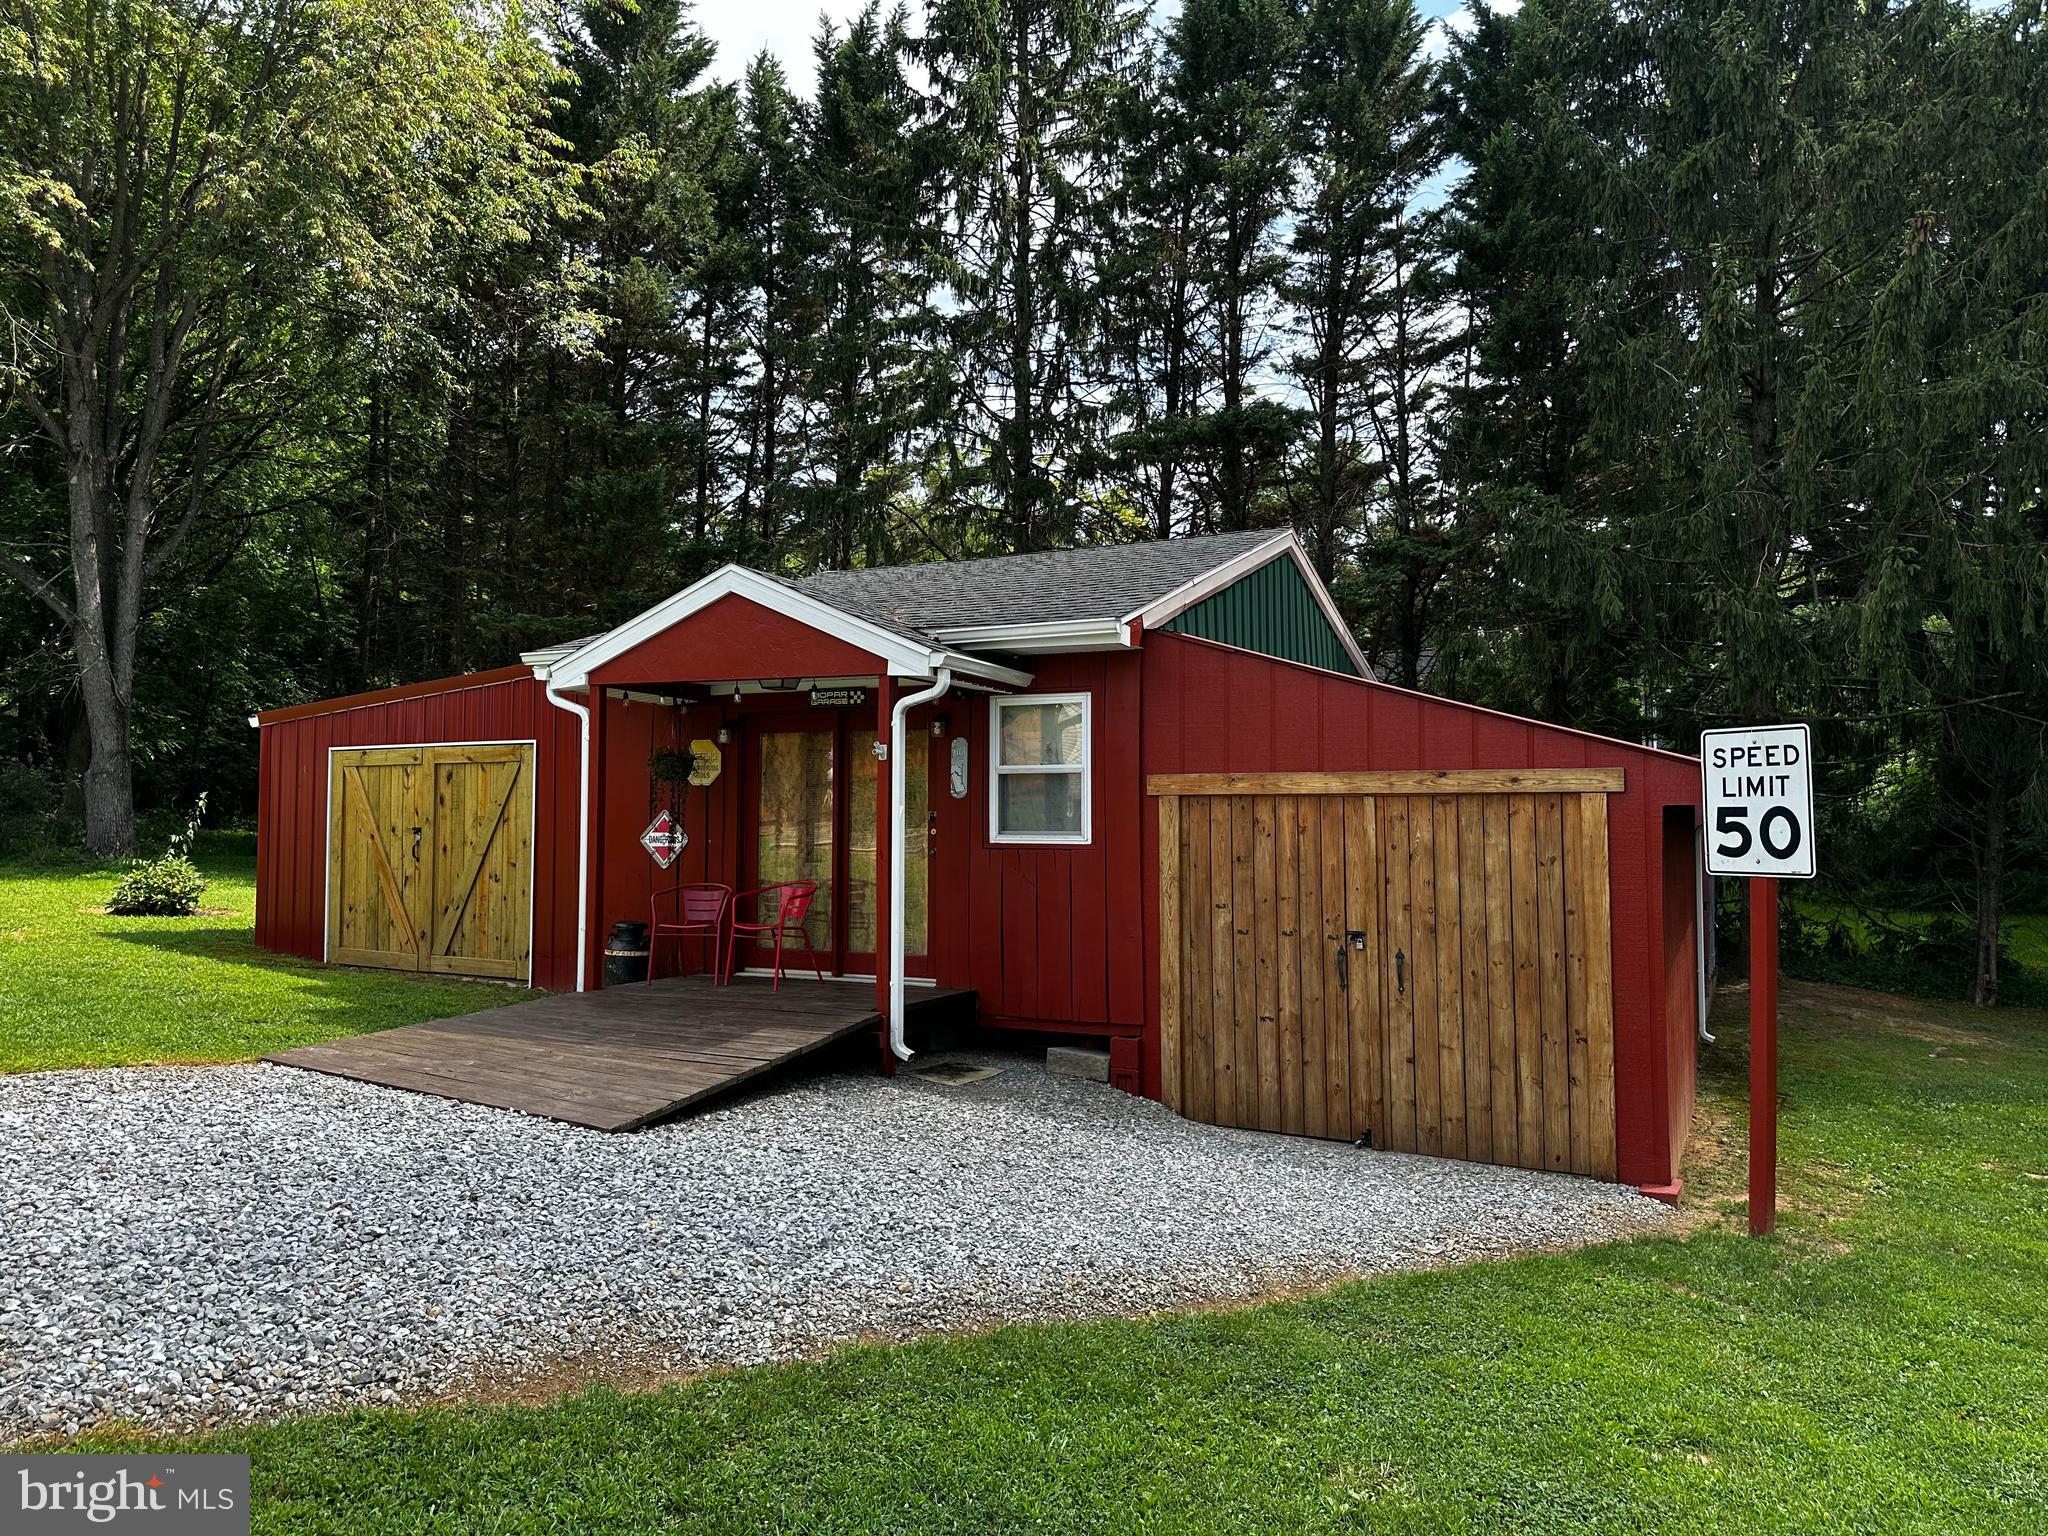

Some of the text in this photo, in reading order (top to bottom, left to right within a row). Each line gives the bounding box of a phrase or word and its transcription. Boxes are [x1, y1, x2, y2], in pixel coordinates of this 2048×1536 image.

[1712, 744, 1800, 769] SPEED
[1722, 775, 1790, 798] LIMIT
[648, 835, 682, 844] DANGES
[1716, 805, 1801, 860] 50
